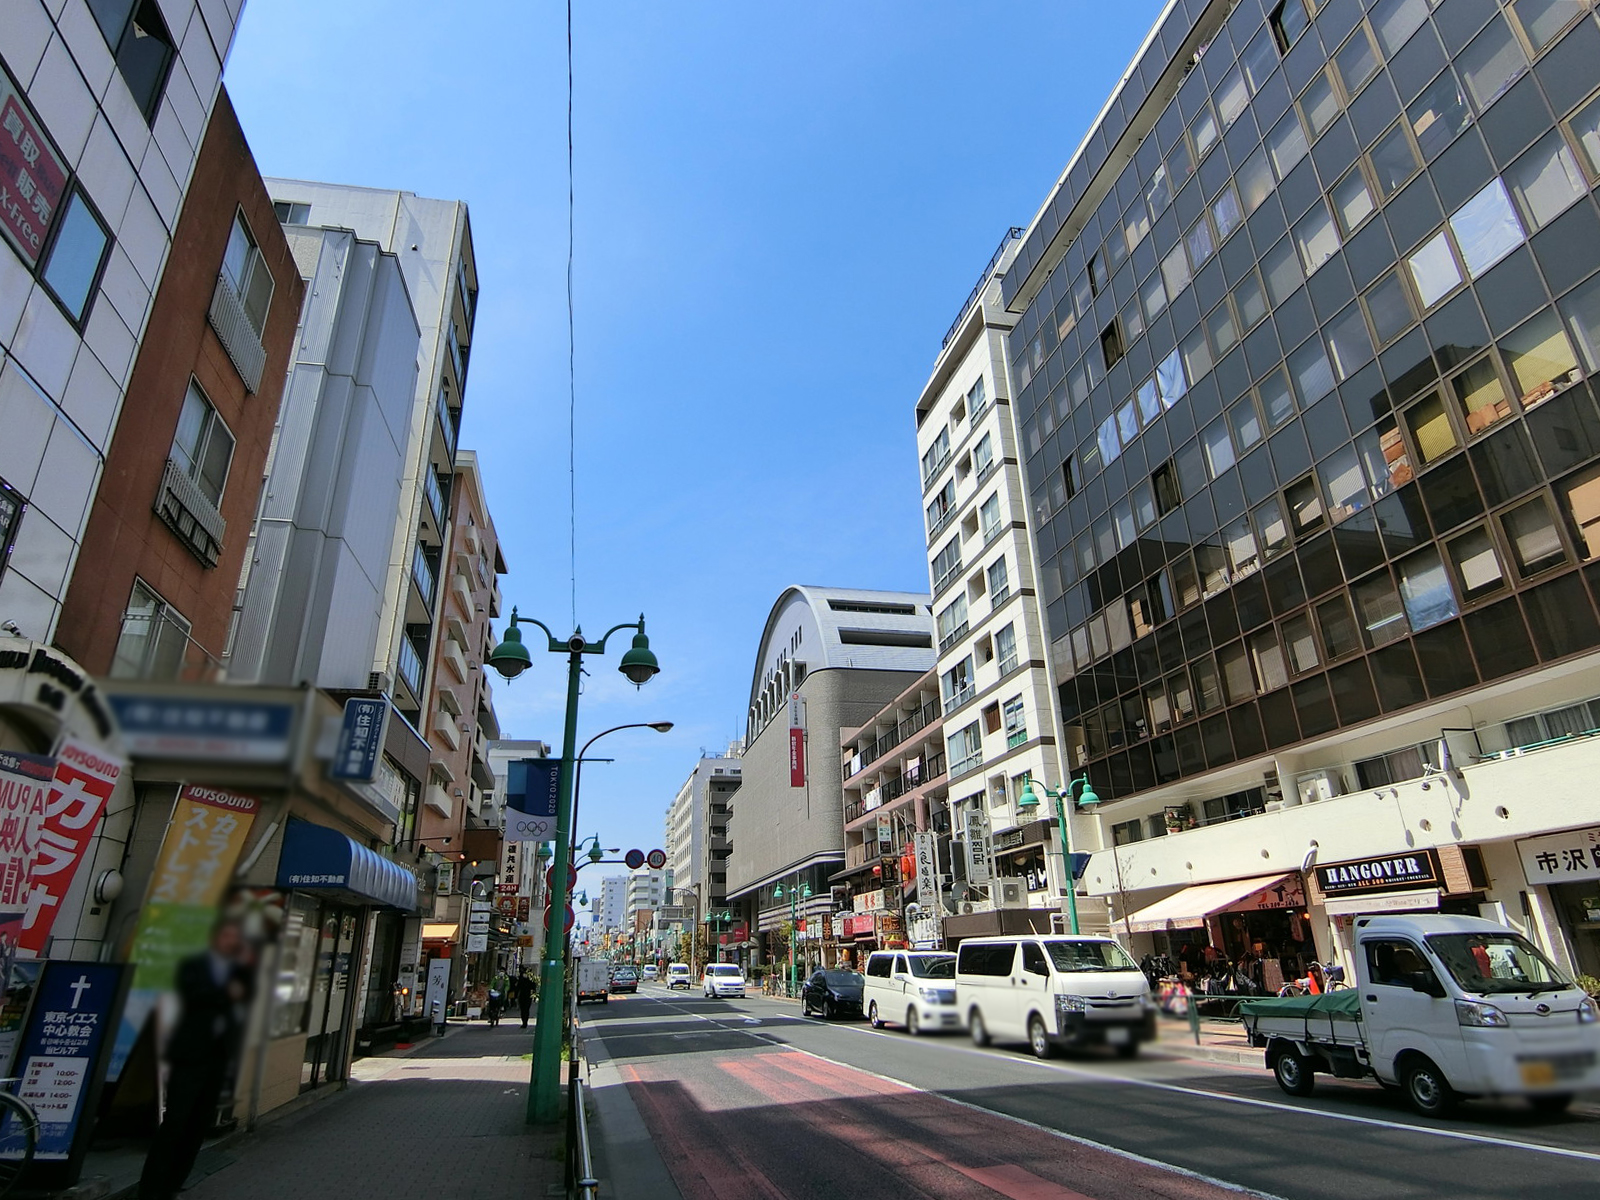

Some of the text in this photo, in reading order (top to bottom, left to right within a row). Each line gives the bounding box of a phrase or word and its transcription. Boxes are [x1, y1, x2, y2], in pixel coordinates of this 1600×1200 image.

[3, 106, 40, 169] 買取
[16, 167, 51, 226] 販売
[61, 744, 120, 778] JOYSOUND
[189, 786, 255, 810] JOYSOUND
[548, 766, 559, 814] TOKYO 2020
[651, 854, 663, 864] 40
[1325, 857, 1420, 883] HANGOVER
[500, 884, 517, 892] 24H
[42, 1011, 98, 1024] 東京イエス
[42, 1025, 92, 1037] 中心教会
